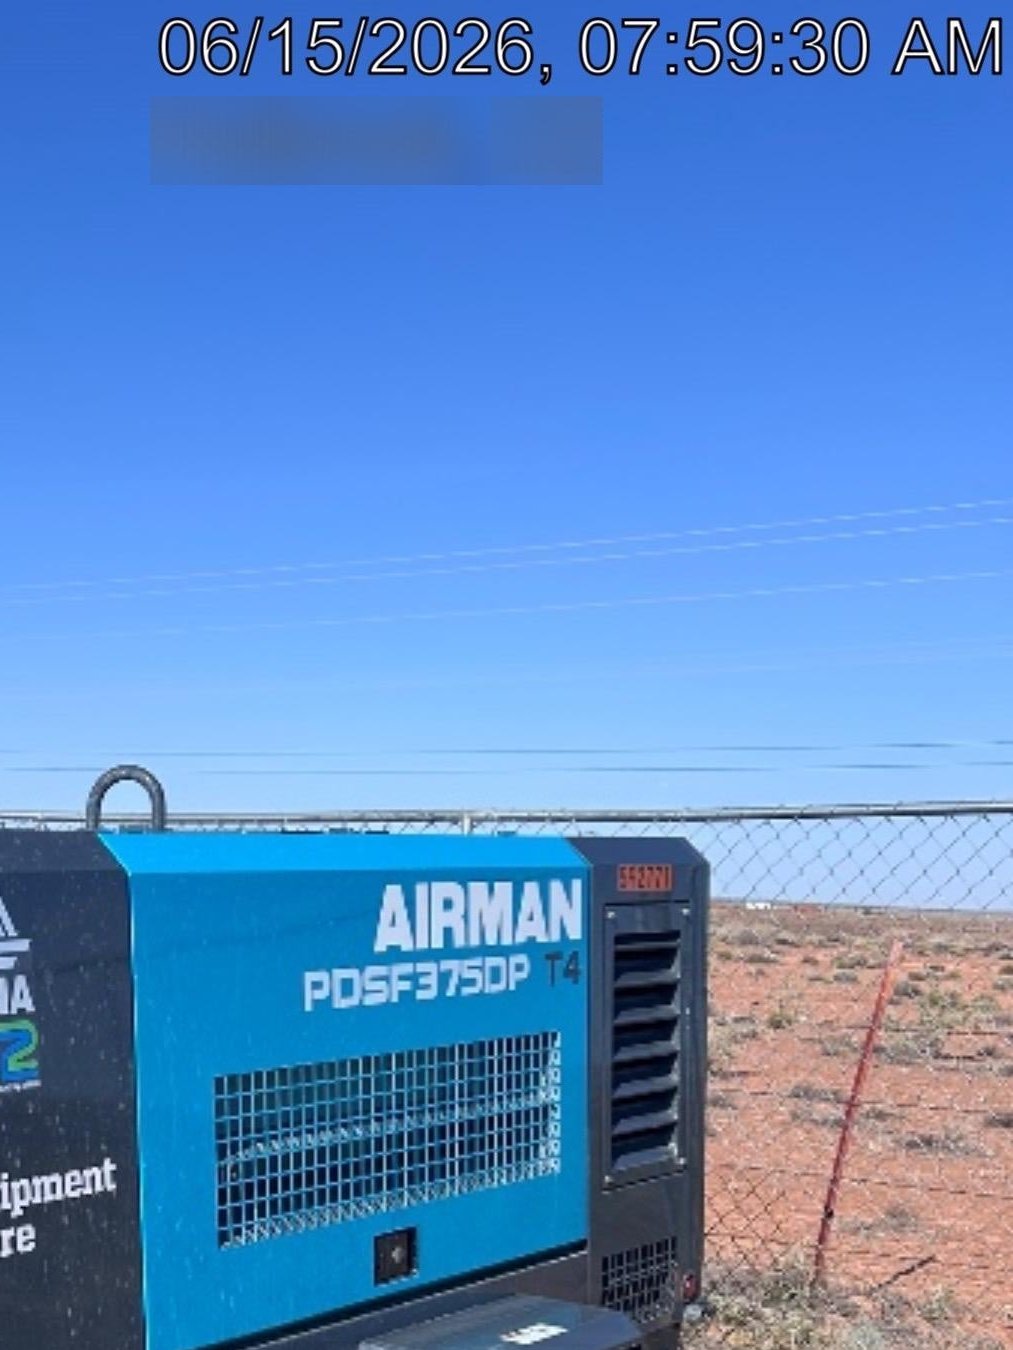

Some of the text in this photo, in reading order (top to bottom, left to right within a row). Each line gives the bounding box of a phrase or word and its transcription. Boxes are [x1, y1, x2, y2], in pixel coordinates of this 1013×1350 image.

[374, 878, 582, 953] AIRMAN
[304, 951, 581, 1012] PDSF375DP T4
